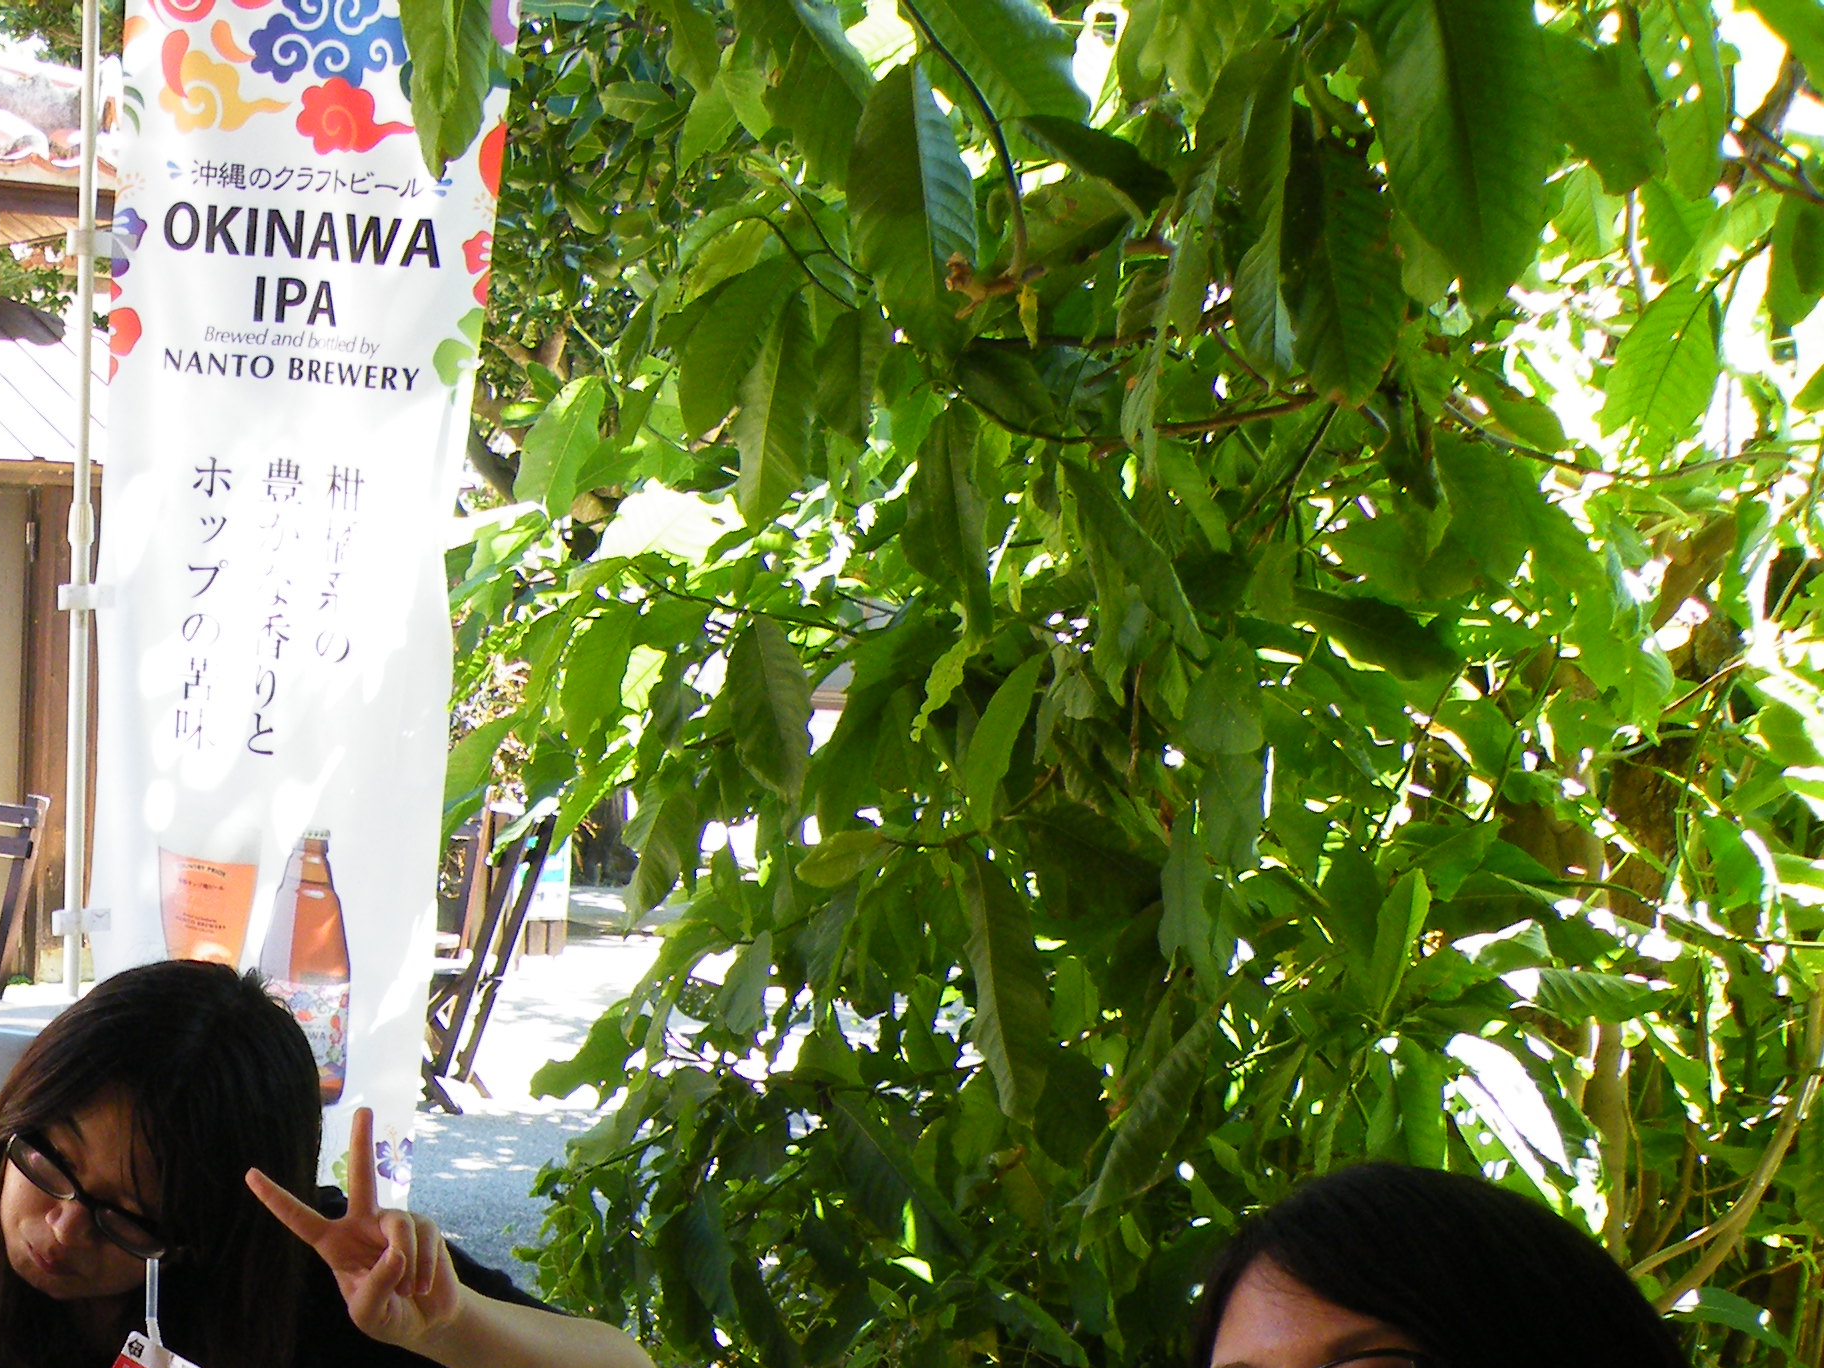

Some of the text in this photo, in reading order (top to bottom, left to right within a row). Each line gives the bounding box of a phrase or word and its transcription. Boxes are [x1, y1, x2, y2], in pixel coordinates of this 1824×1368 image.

[191, 159, 425, 199] 沖縄のクラフトビール
[163, 201, 441, 269] OKINAWA
[252, 275, 337, 328] IPA
[204, 326, 381, 359] Brewed and bottled by
[163, 347, 420, 392] NANTO BREWERY
[175, 456, 232, 750] ホップの苦味
